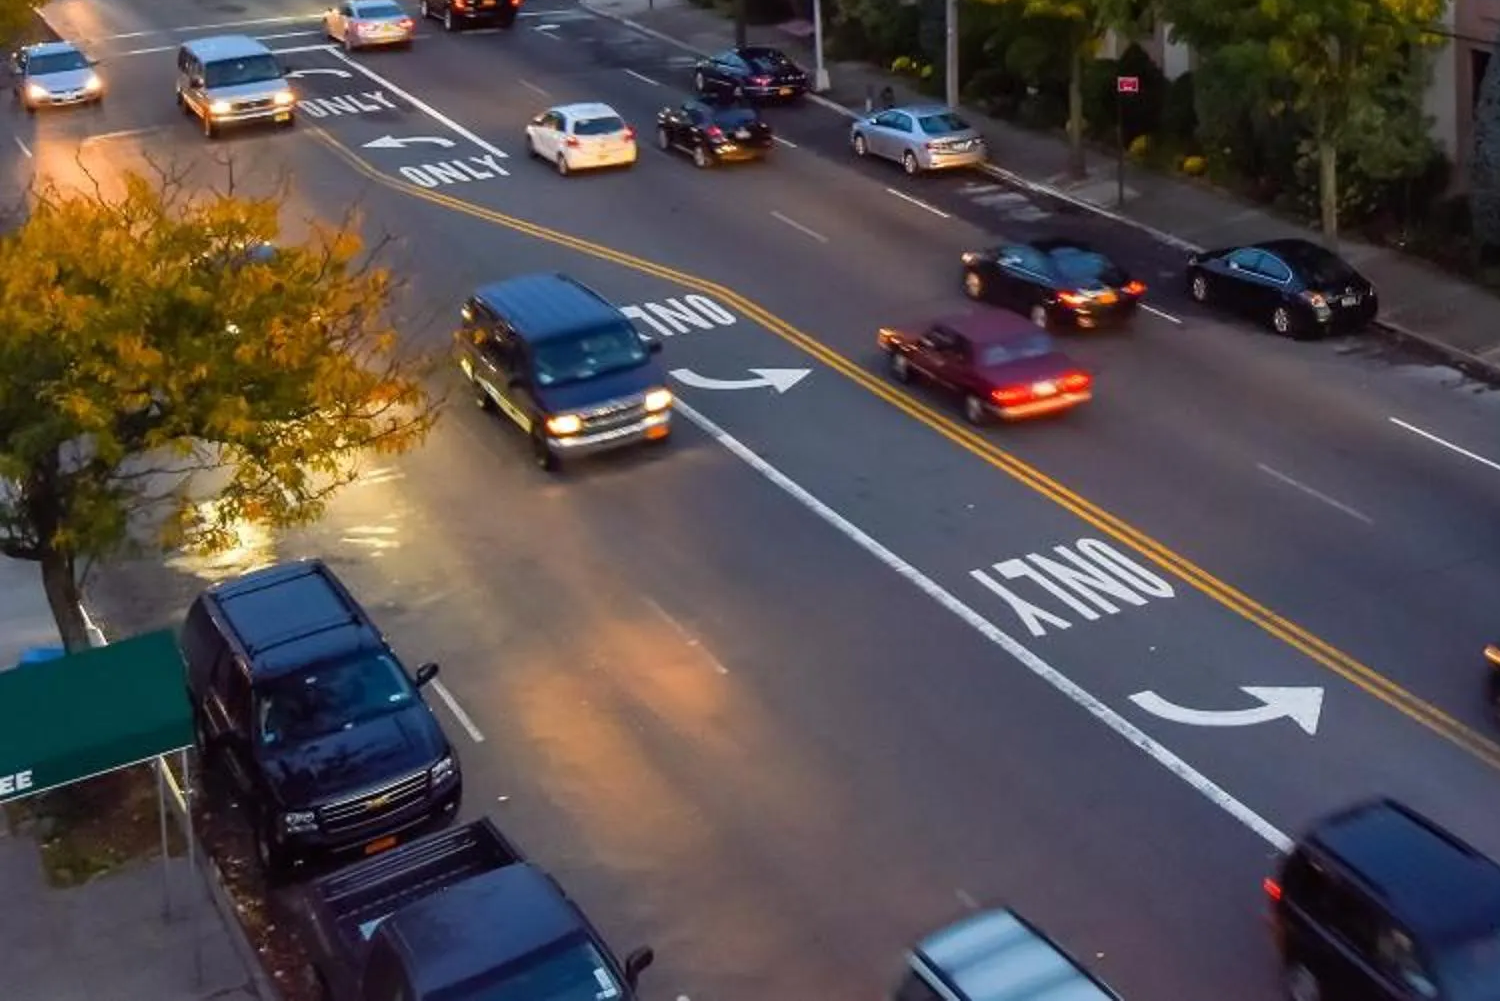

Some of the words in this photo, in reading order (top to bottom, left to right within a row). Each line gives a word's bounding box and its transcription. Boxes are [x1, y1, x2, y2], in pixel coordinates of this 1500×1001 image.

[298, 91, 397, 118] ONLY
[400, 154, 511, 188] ONLY
[619, 294, 737, 340] ONL
[969, 538, 1175, 637] ONLY
